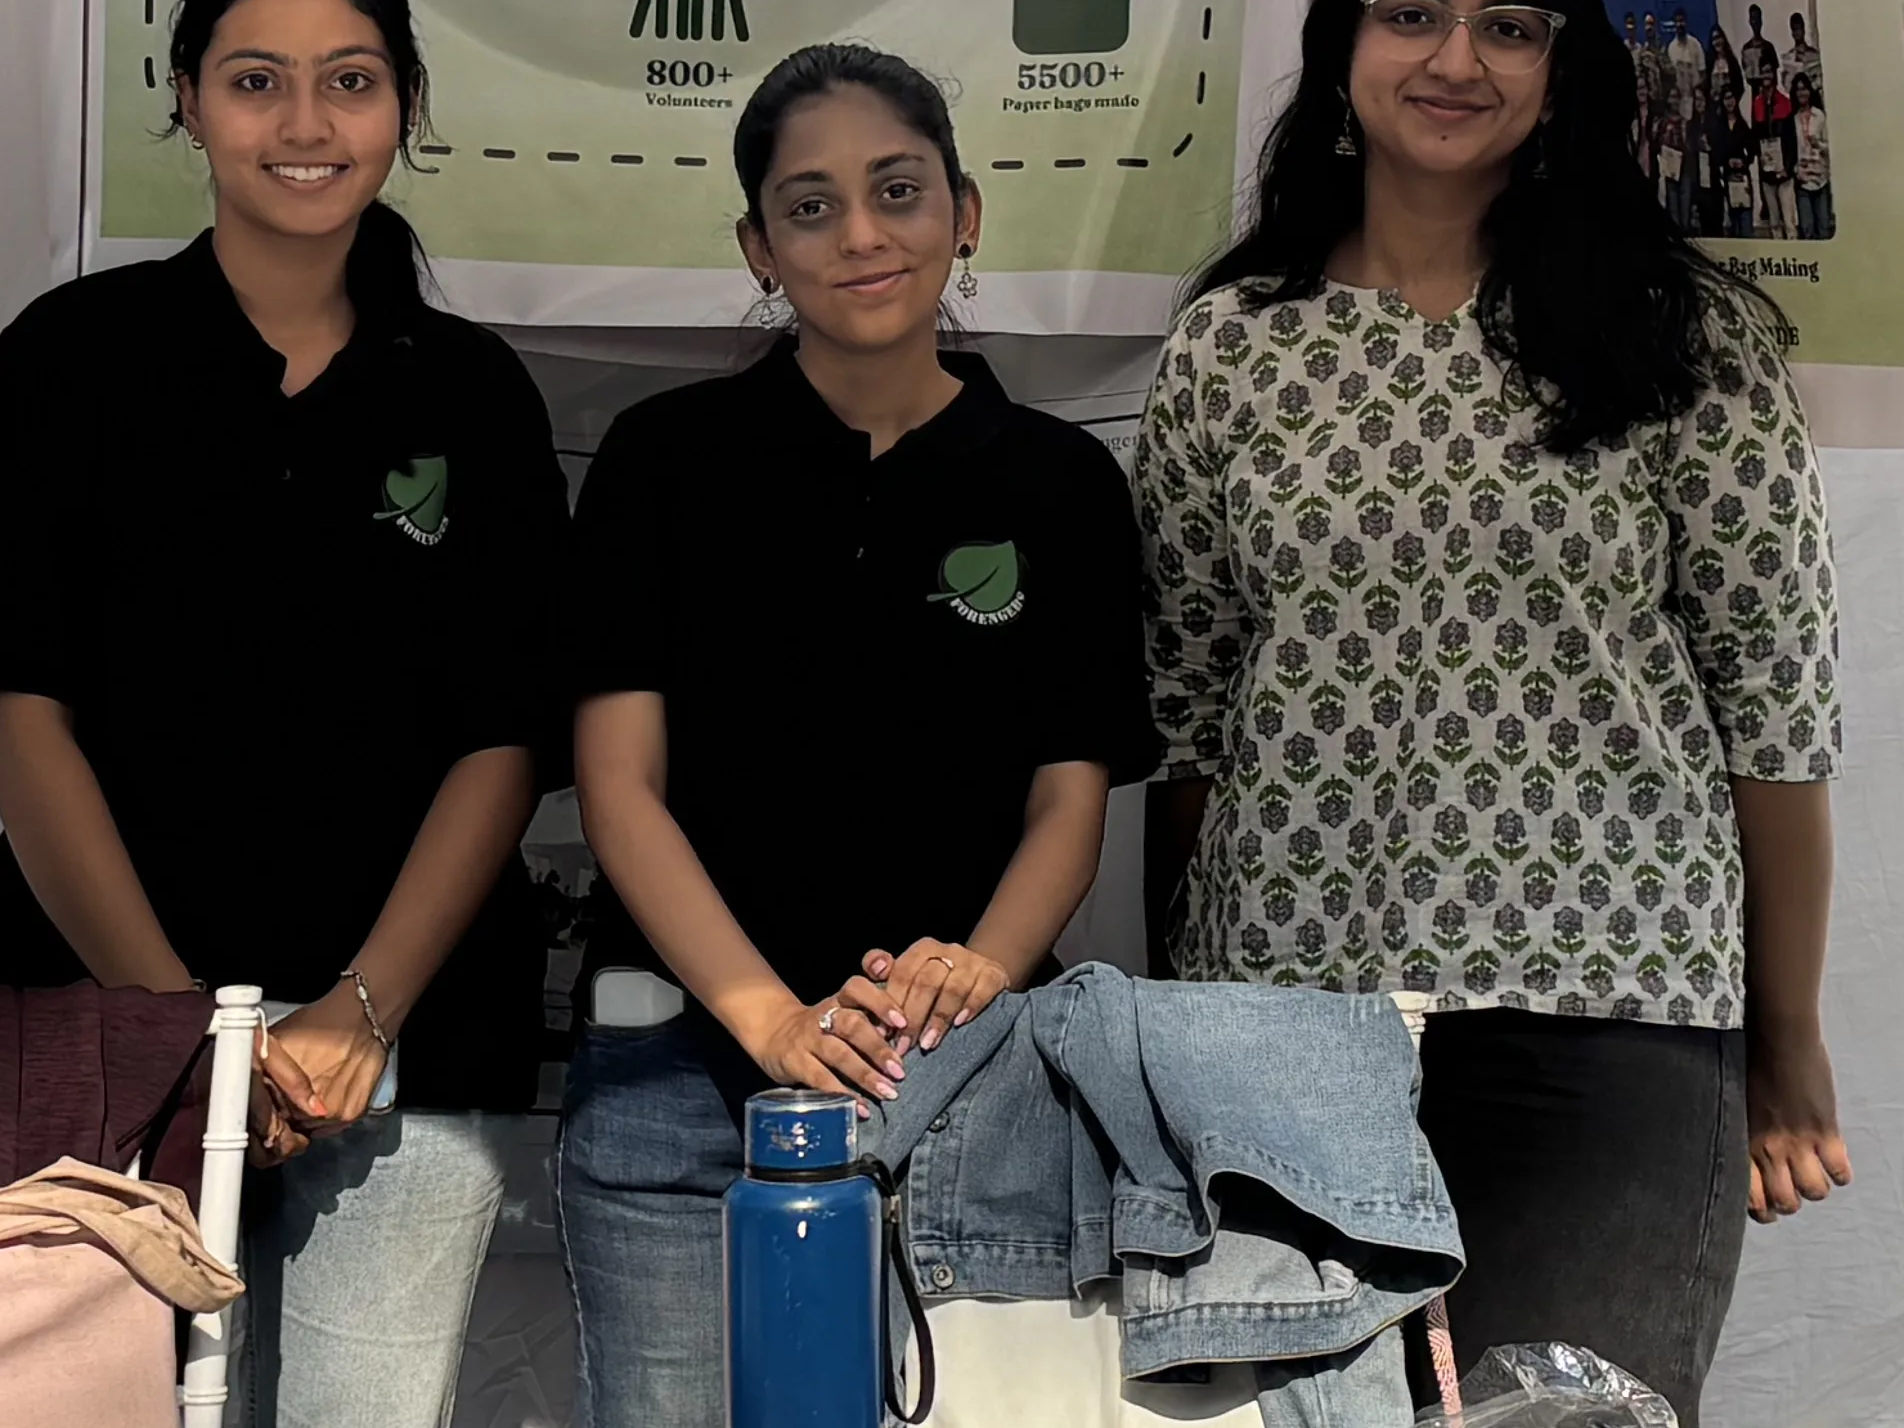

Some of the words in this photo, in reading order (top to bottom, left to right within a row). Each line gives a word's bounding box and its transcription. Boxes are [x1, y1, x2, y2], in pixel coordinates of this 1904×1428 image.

[646, 59, 734, 87] 800+
[1017, 61, 1125, 90] 5500+
[645, 92, 733, 108] Volunteers
[1759, 257, 1821, 283] Making
